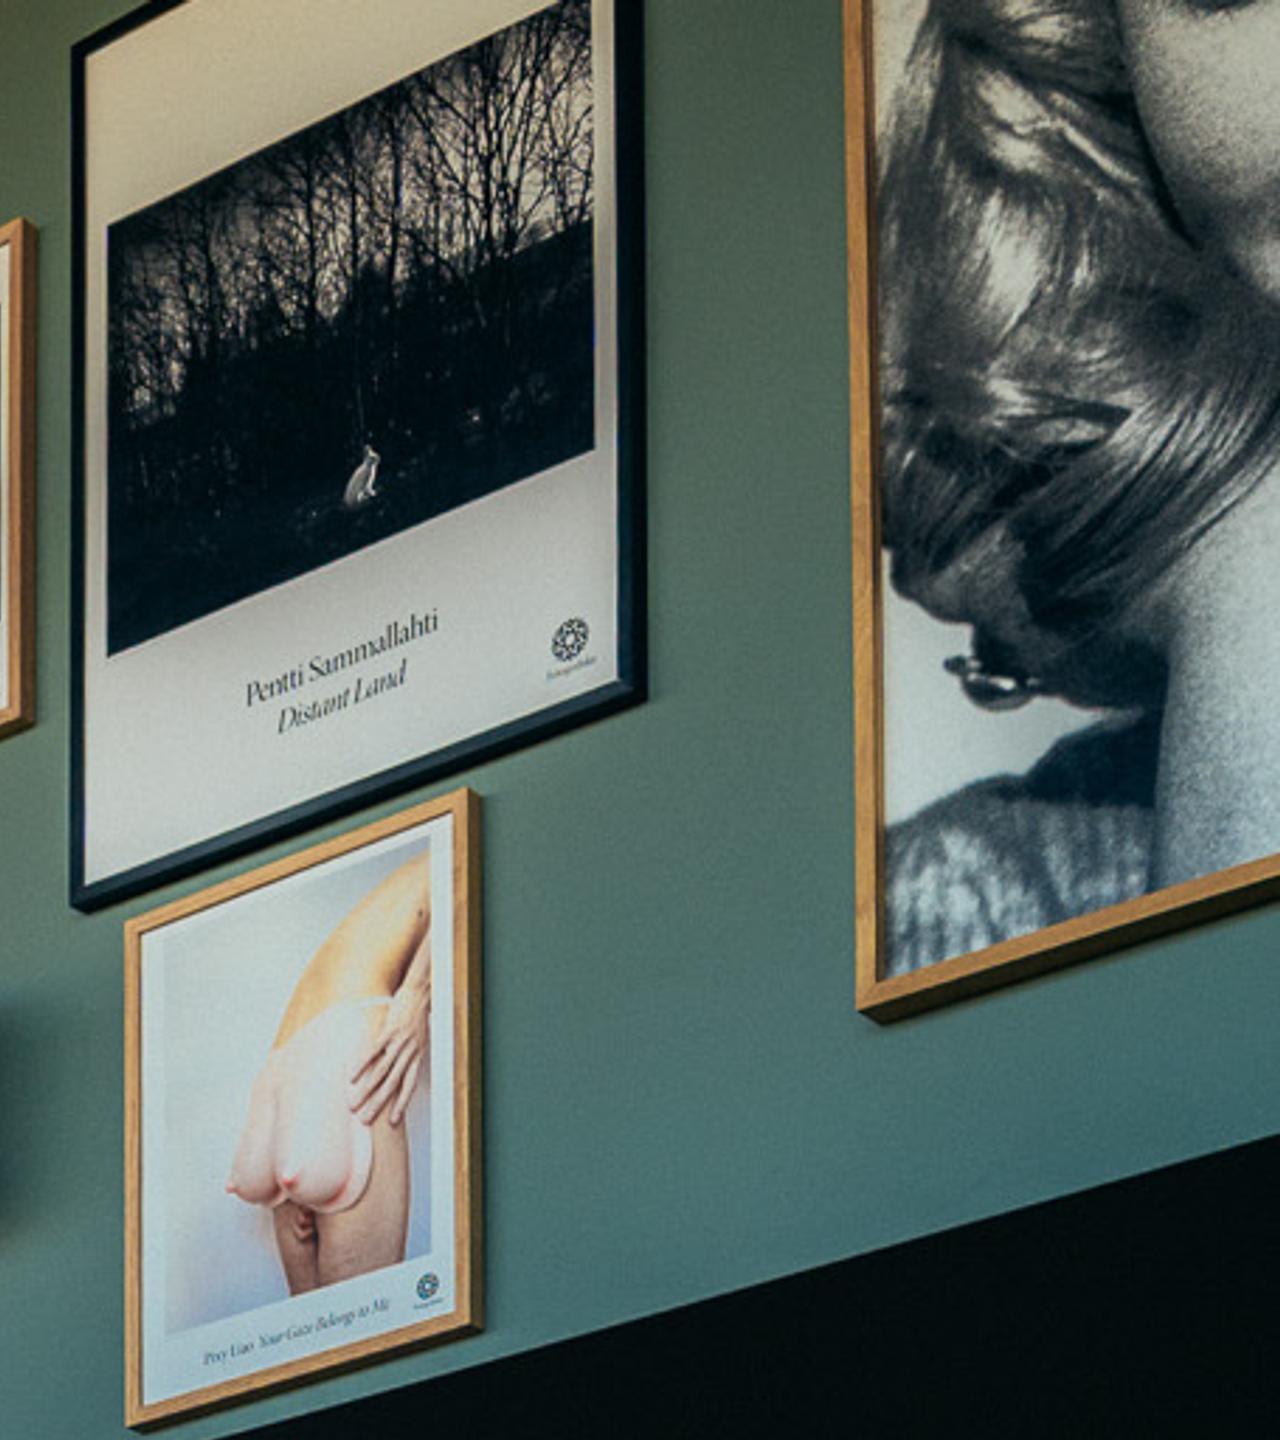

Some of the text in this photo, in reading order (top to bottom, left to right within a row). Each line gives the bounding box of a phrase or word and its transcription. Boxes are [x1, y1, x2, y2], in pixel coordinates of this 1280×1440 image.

[246, 608, 438, 708] Pentti Sammallahti
[277, 658, 408, 735] Distant Land
